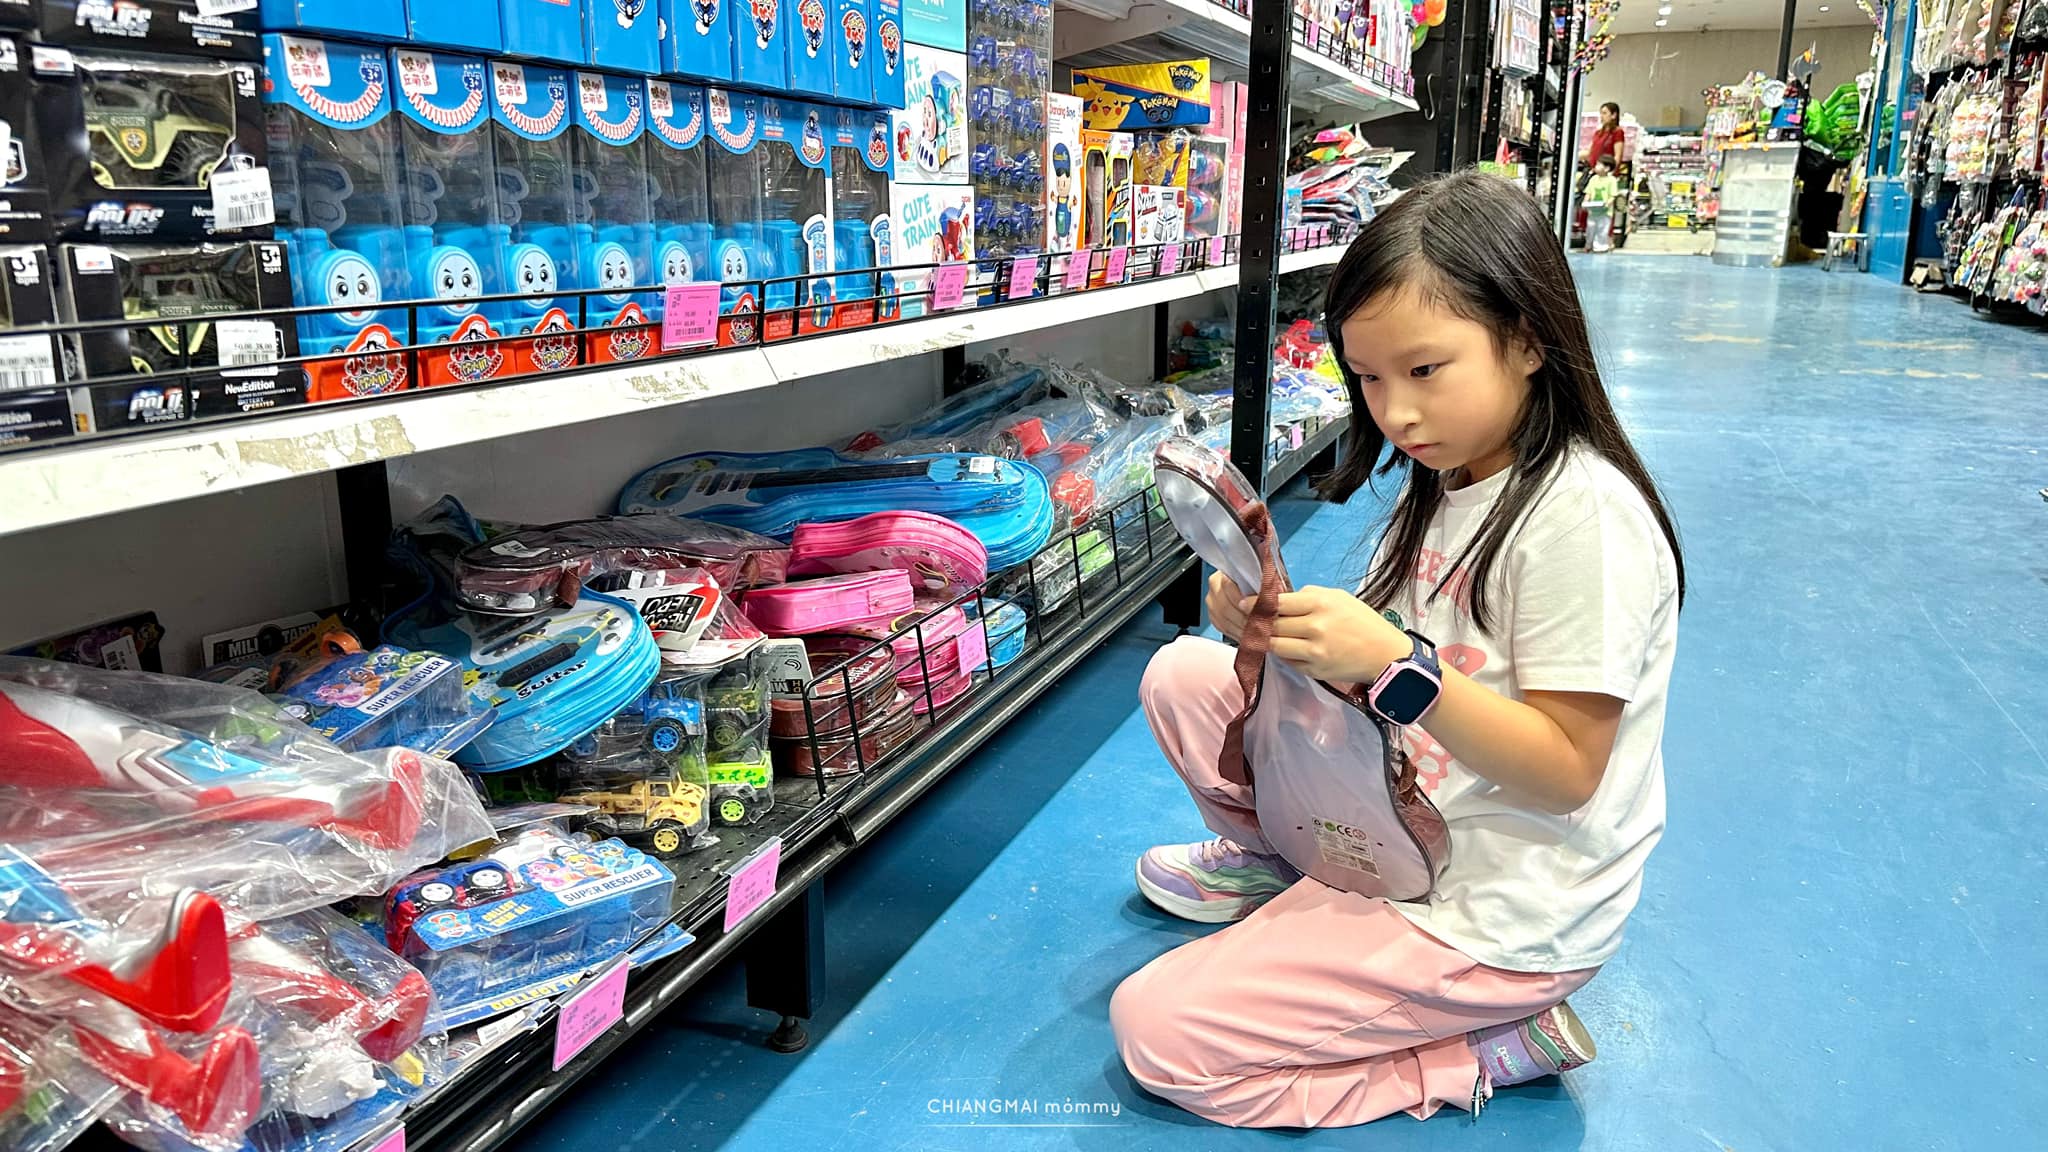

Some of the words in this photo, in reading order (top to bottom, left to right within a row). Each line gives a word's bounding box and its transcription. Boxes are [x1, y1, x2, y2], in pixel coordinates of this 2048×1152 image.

[903, 192, 932, 224] CUTE
[903, 215, 937, 250] TRAIN
[224, 380, 275, 395] NewEdition
[366, 689, 401, 712] SUPER
[399, 660, 445, 692] RESCUER
[562, 884, 603, 903] SUPER
[603, 867, 655, 891] RESCUER
